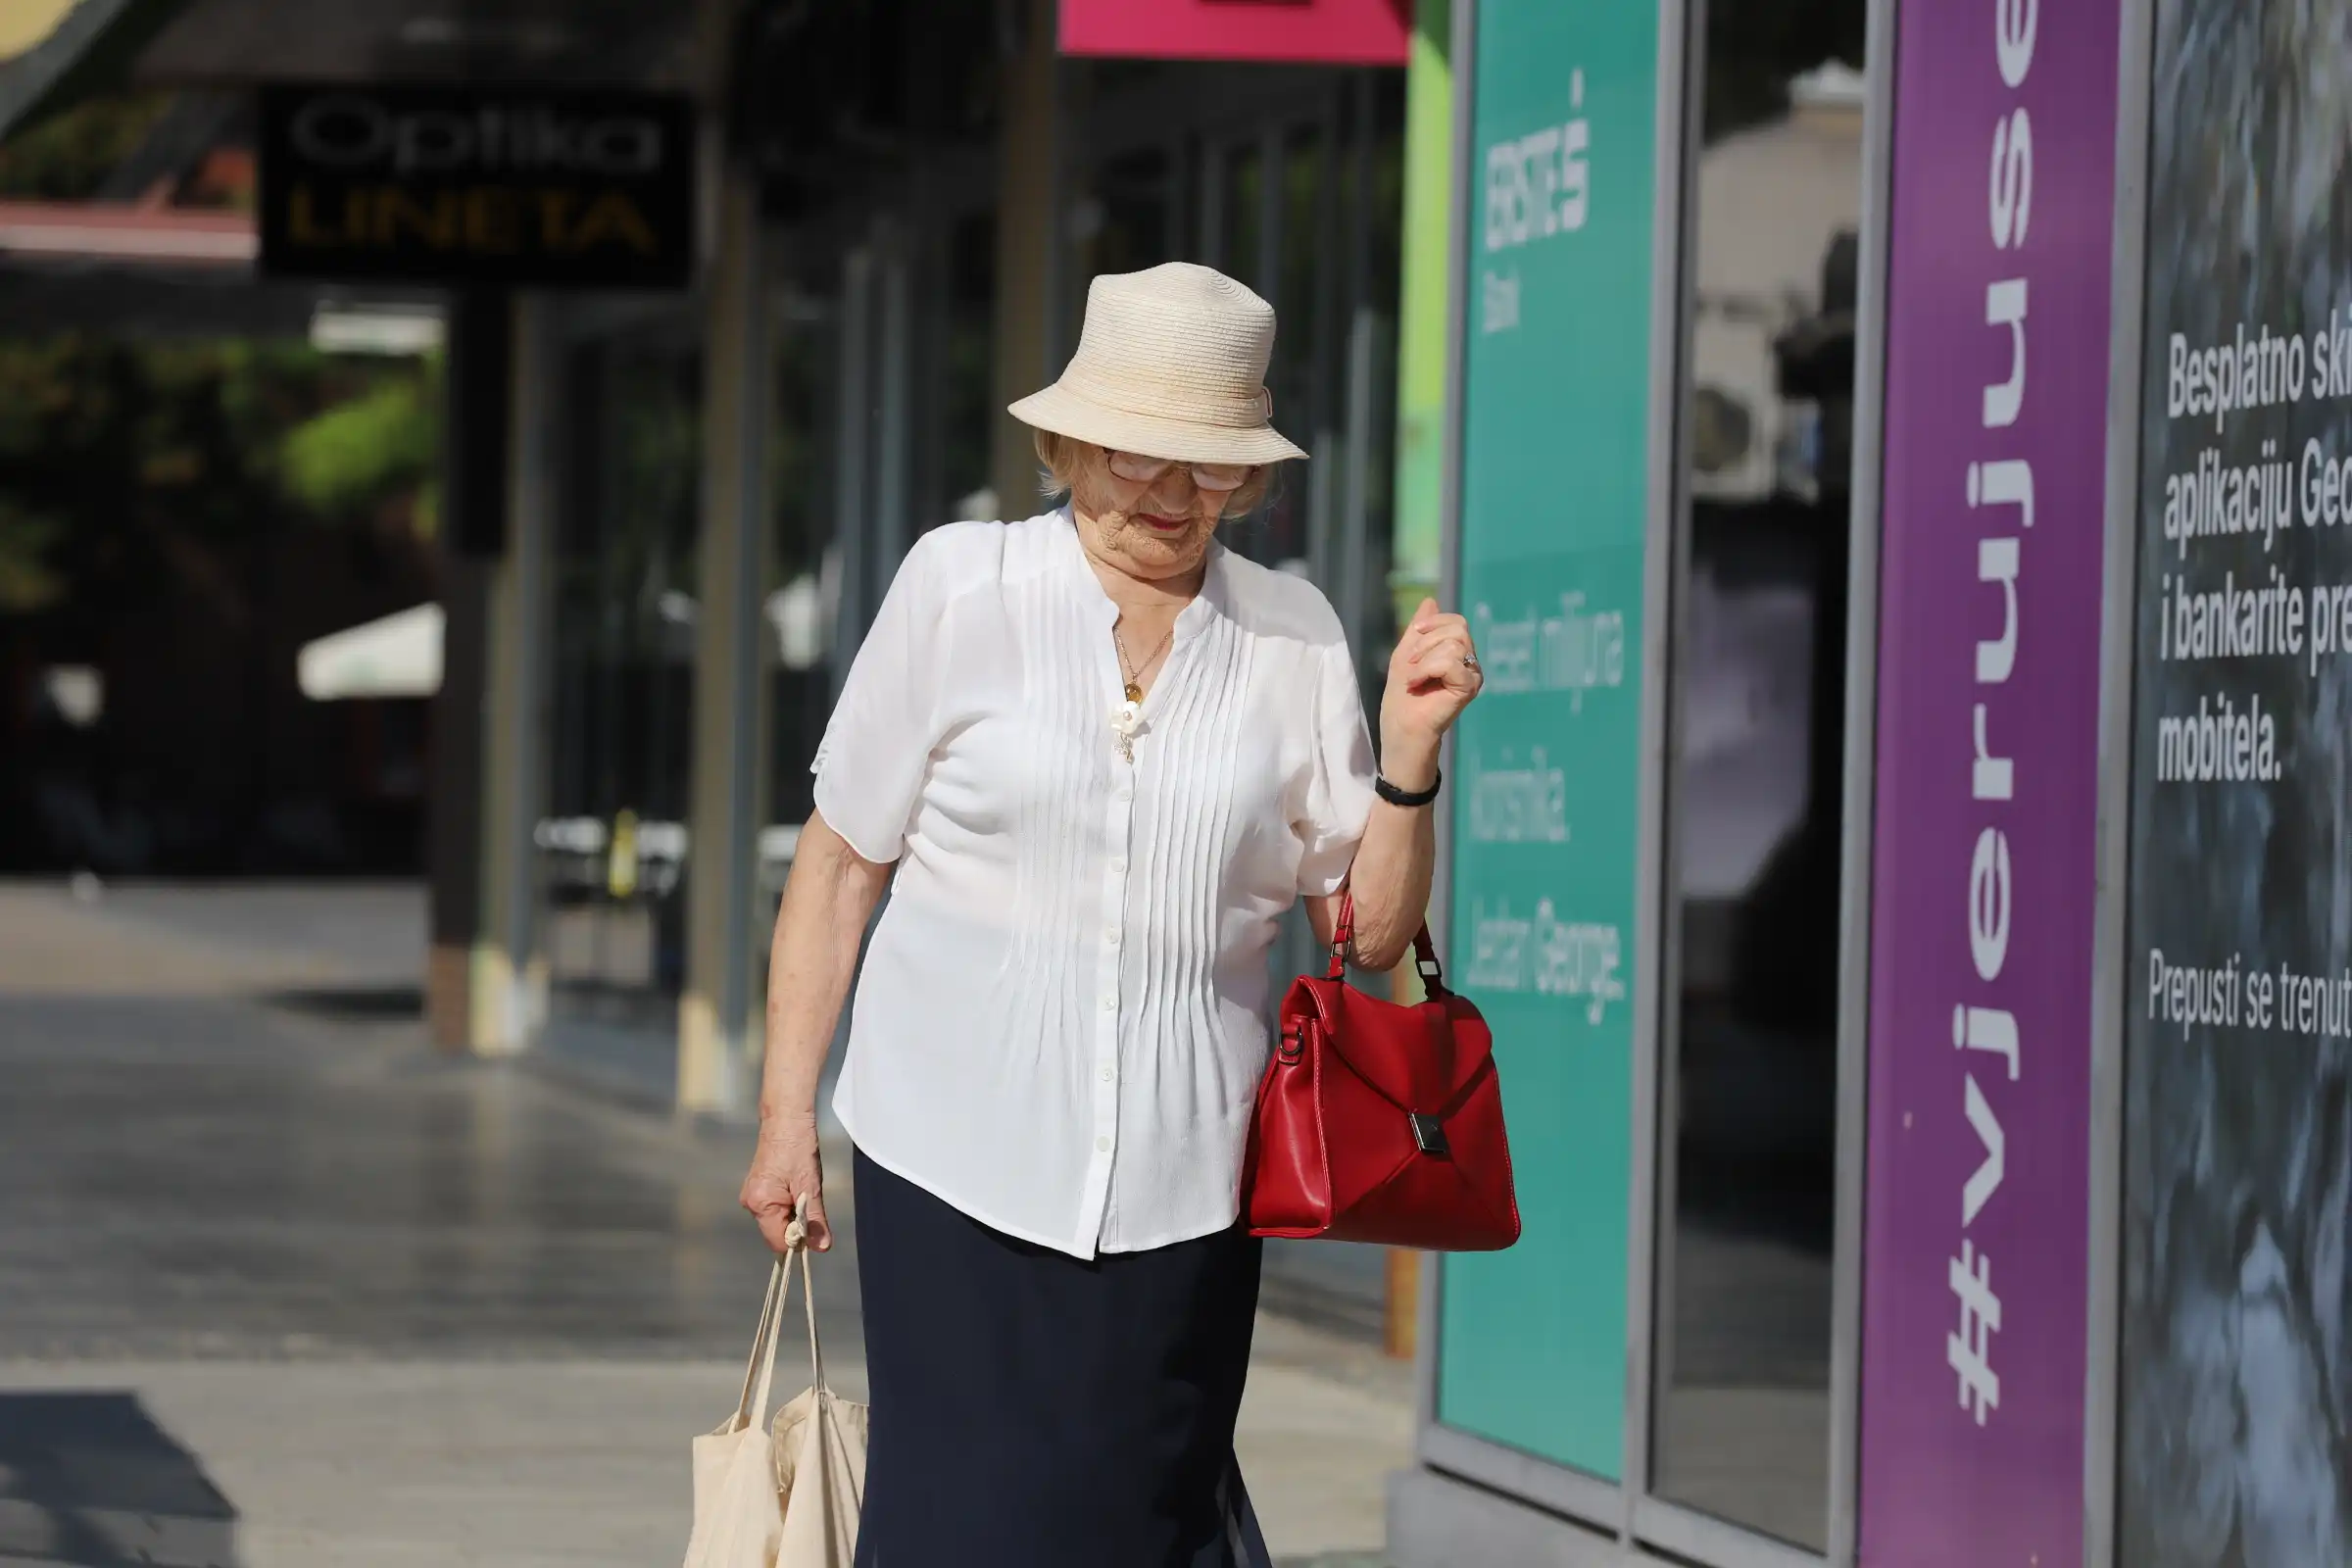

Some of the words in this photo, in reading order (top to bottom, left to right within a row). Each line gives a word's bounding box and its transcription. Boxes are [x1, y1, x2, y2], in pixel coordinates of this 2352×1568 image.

[289, 93, 662, 178] Optika
[288, 182, 661, 255] LINETA
[2168, 321, 2305, 434] Besplatno
[2164, 439, 2293, 561] aplikaciju
[2160, 572, 2171, 661] i
[2175, 564, 2304, 660] bankarite
[2311, 584, 2352, 677] pre
[2158, 691, 2281, 781] mobitela.
[2148, 947, 2241, 1043] Prepusti
[2245, 970, 2274, 1030] se
